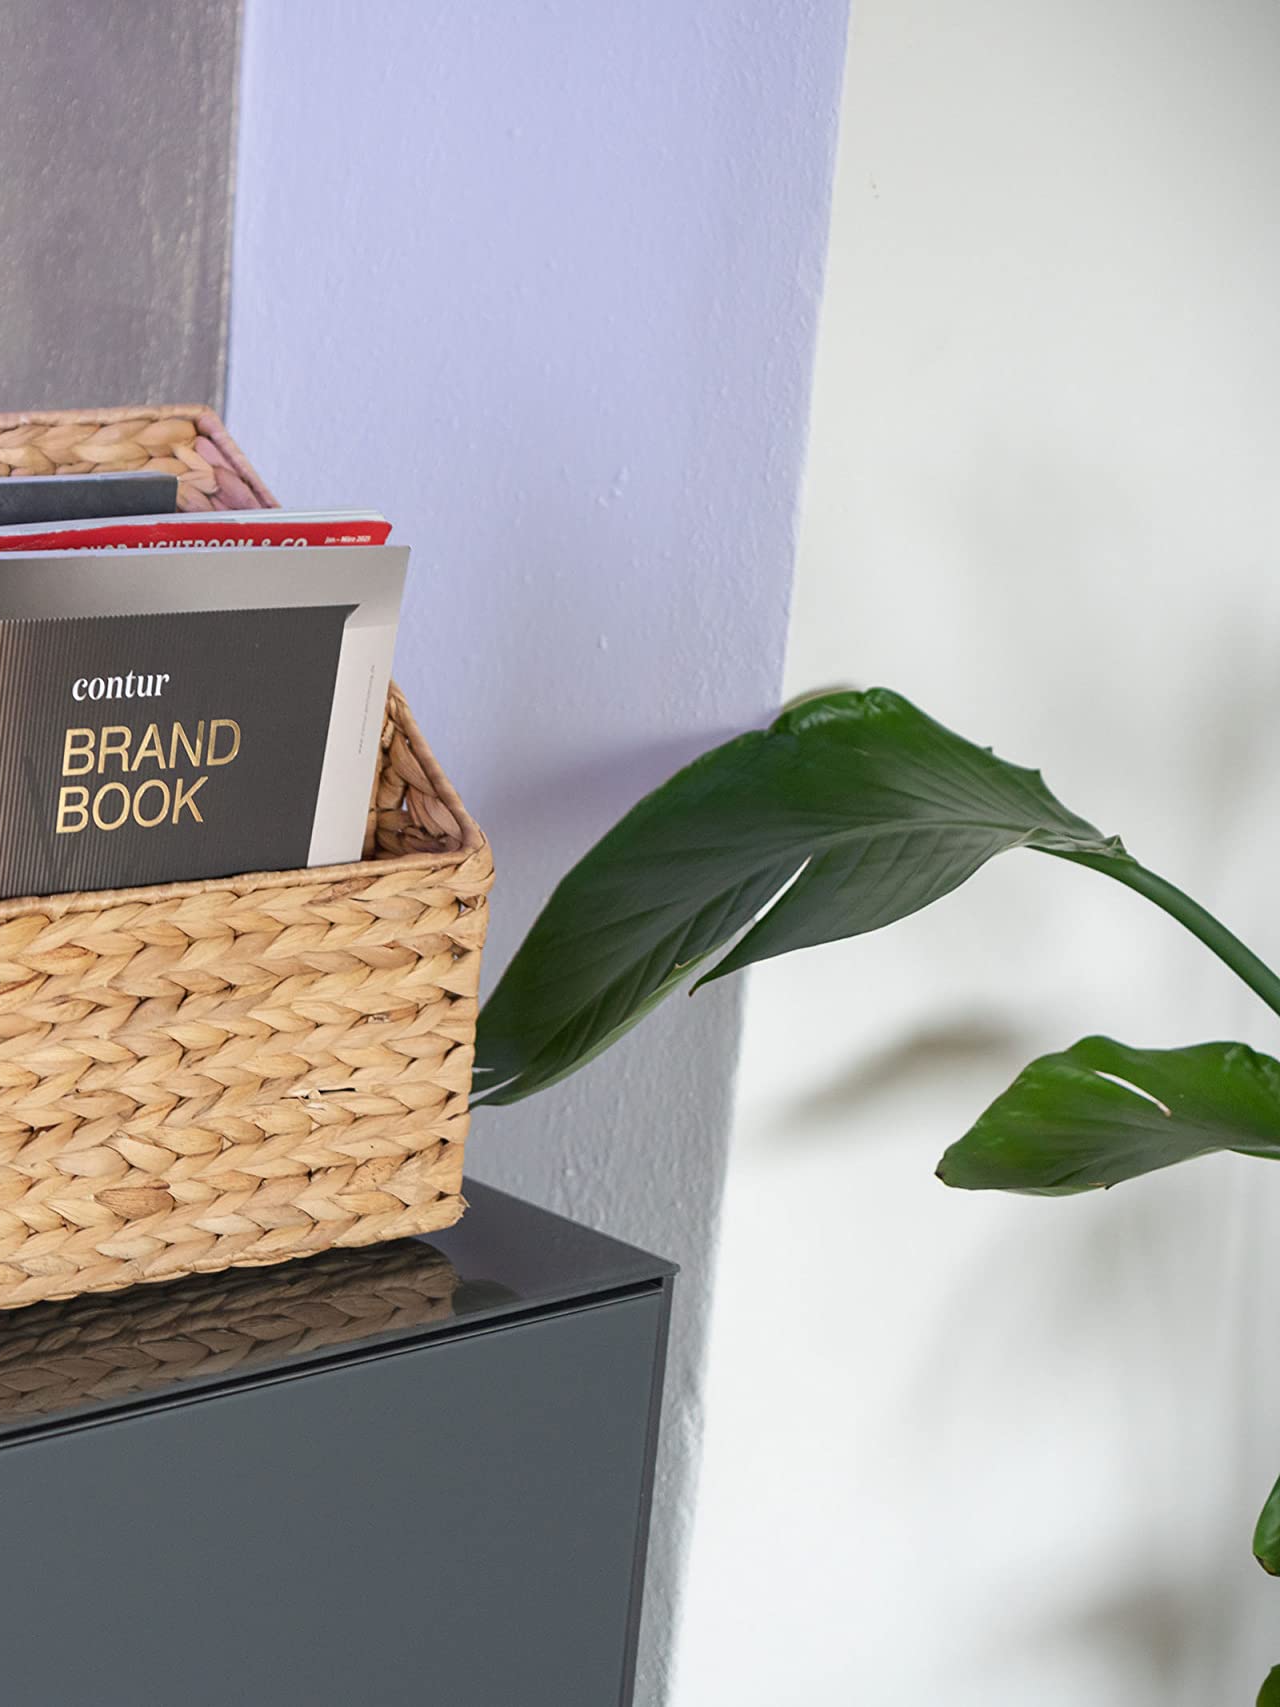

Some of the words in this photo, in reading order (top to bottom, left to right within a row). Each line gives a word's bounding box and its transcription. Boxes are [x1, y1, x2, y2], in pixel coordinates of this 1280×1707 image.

[72, 669, 170, 701] contur
[62, 719, 241, 776] BRAND
[56, 776, 208, 834] BOOK
